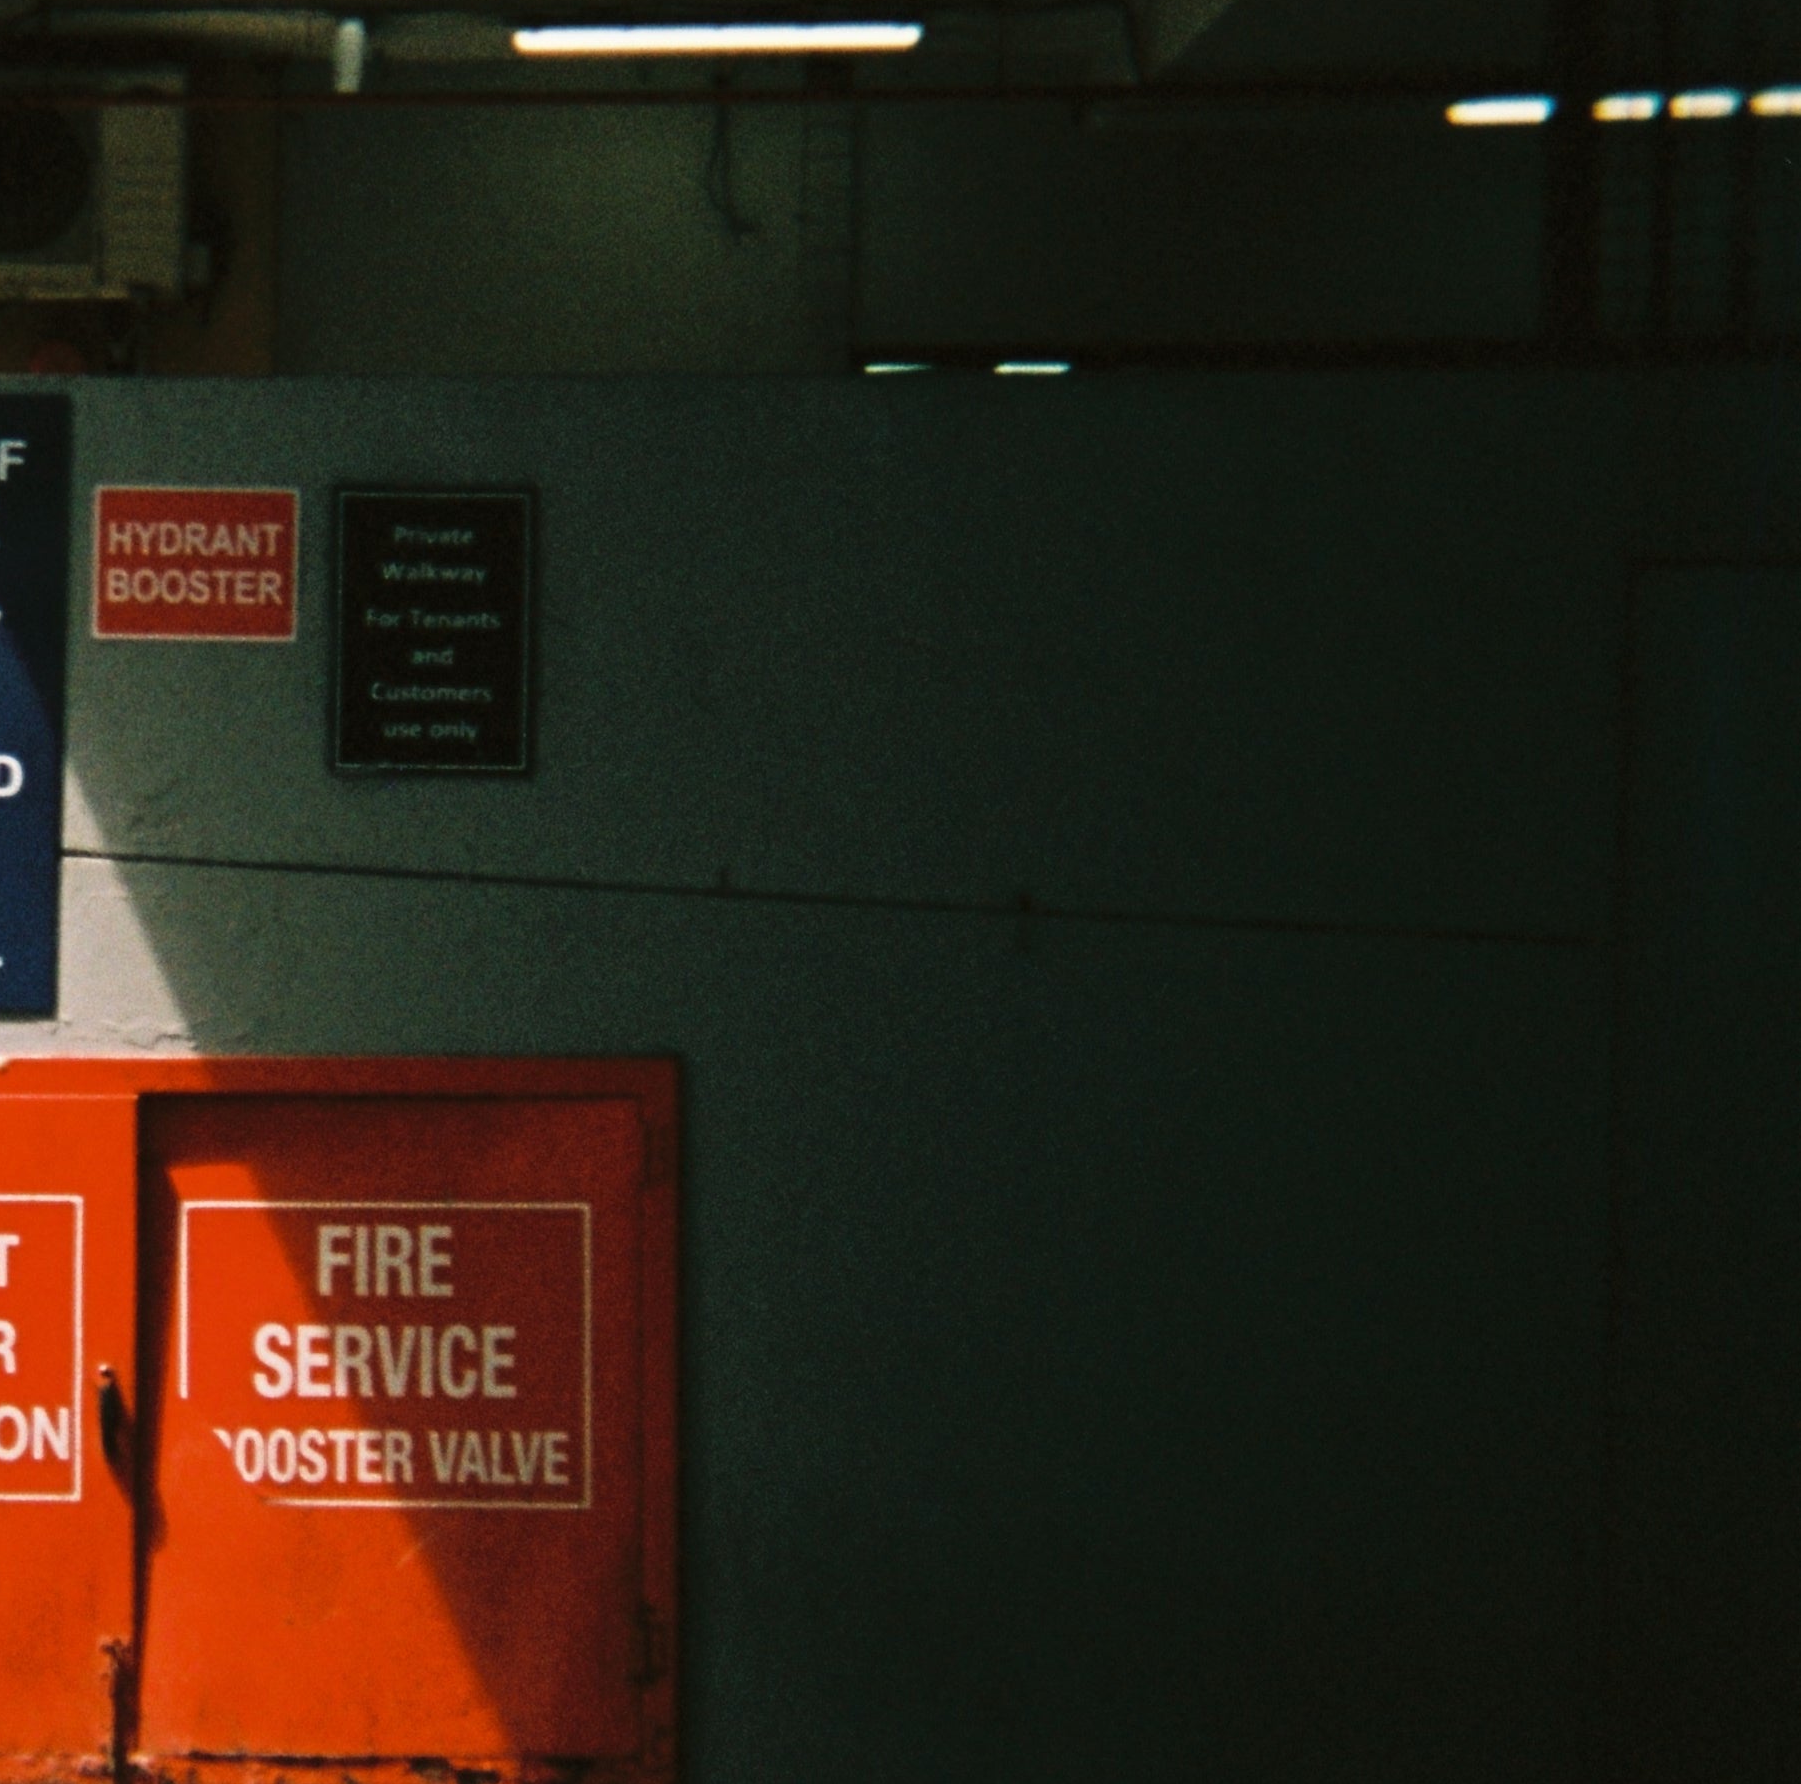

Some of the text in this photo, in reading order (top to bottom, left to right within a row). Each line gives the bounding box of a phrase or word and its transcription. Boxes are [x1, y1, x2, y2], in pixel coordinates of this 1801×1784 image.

[108, 521, 283, 557] HYDRANT
[394, 525, 474, 545] Private
[382, 562, 487, 584] Walkway
[106, 567, 282, 606] BOOSTER
[365, 607, 502, 630] For Tenants
[412, 644, 455, 665] and
[370, 680, 494, 703] Customers
[383, 720, 478, 742] use only
[317, 1225, 454, 1297] FIRE
[253, 1322, 517, 1399] SERVICE
[213, 1428, 570, 1485] OOSTER VALVE
